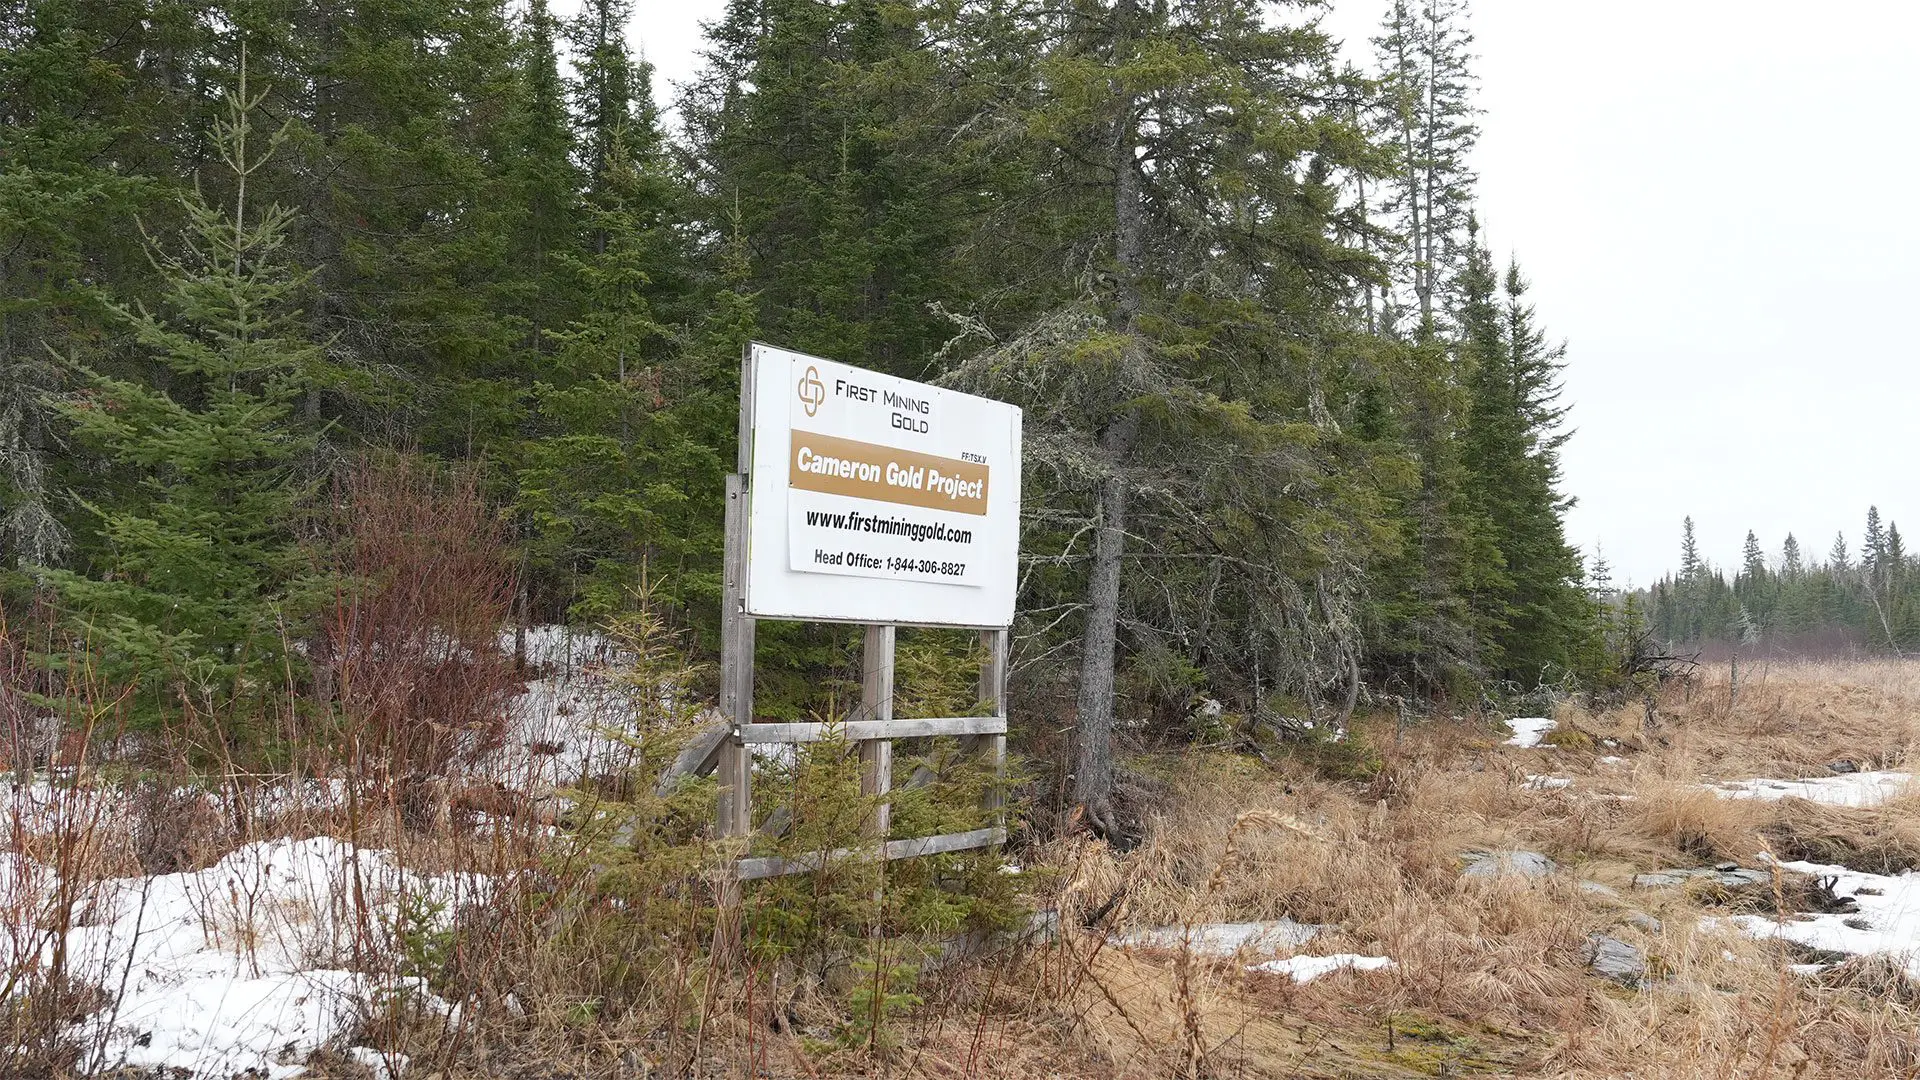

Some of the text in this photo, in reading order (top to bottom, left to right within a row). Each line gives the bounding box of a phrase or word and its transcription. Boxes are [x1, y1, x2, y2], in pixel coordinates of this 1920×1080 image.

[836, 379, 929, 414] FIRST MINING
[891, 412, 929, 434] GOLD
[797, 446, 983, 499] Cameron Gold Project
[806, 511, 972, 544] www.firstmininggold.com
[814, 549, 966, 577] Head Office: 1-844-306-8827
